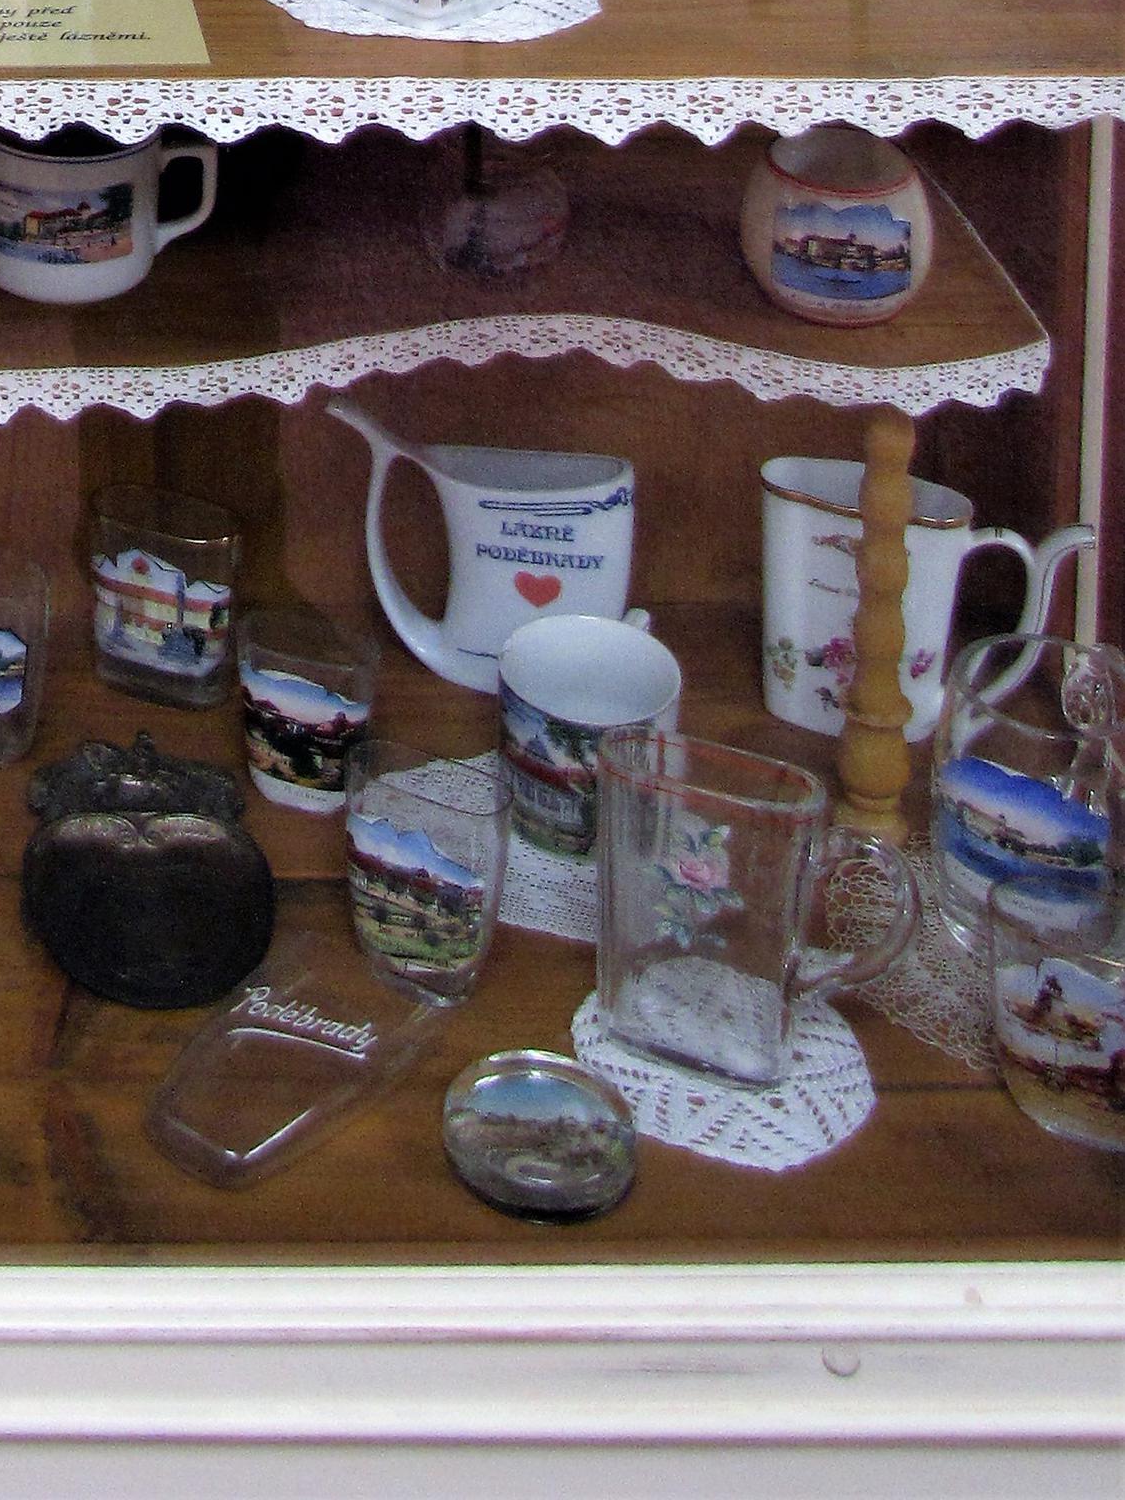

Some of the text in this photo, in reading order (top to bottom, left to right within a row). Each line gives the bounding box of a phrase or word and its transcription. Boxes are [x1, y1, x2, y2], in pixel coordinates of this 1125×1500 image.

[26, 5, 79, 18] před
[58, 30, 152, 41] lázněmi.
[475, 542, 604, 569] PODĚBRADY
[230, 986, 379, 1050] Poděbrady
